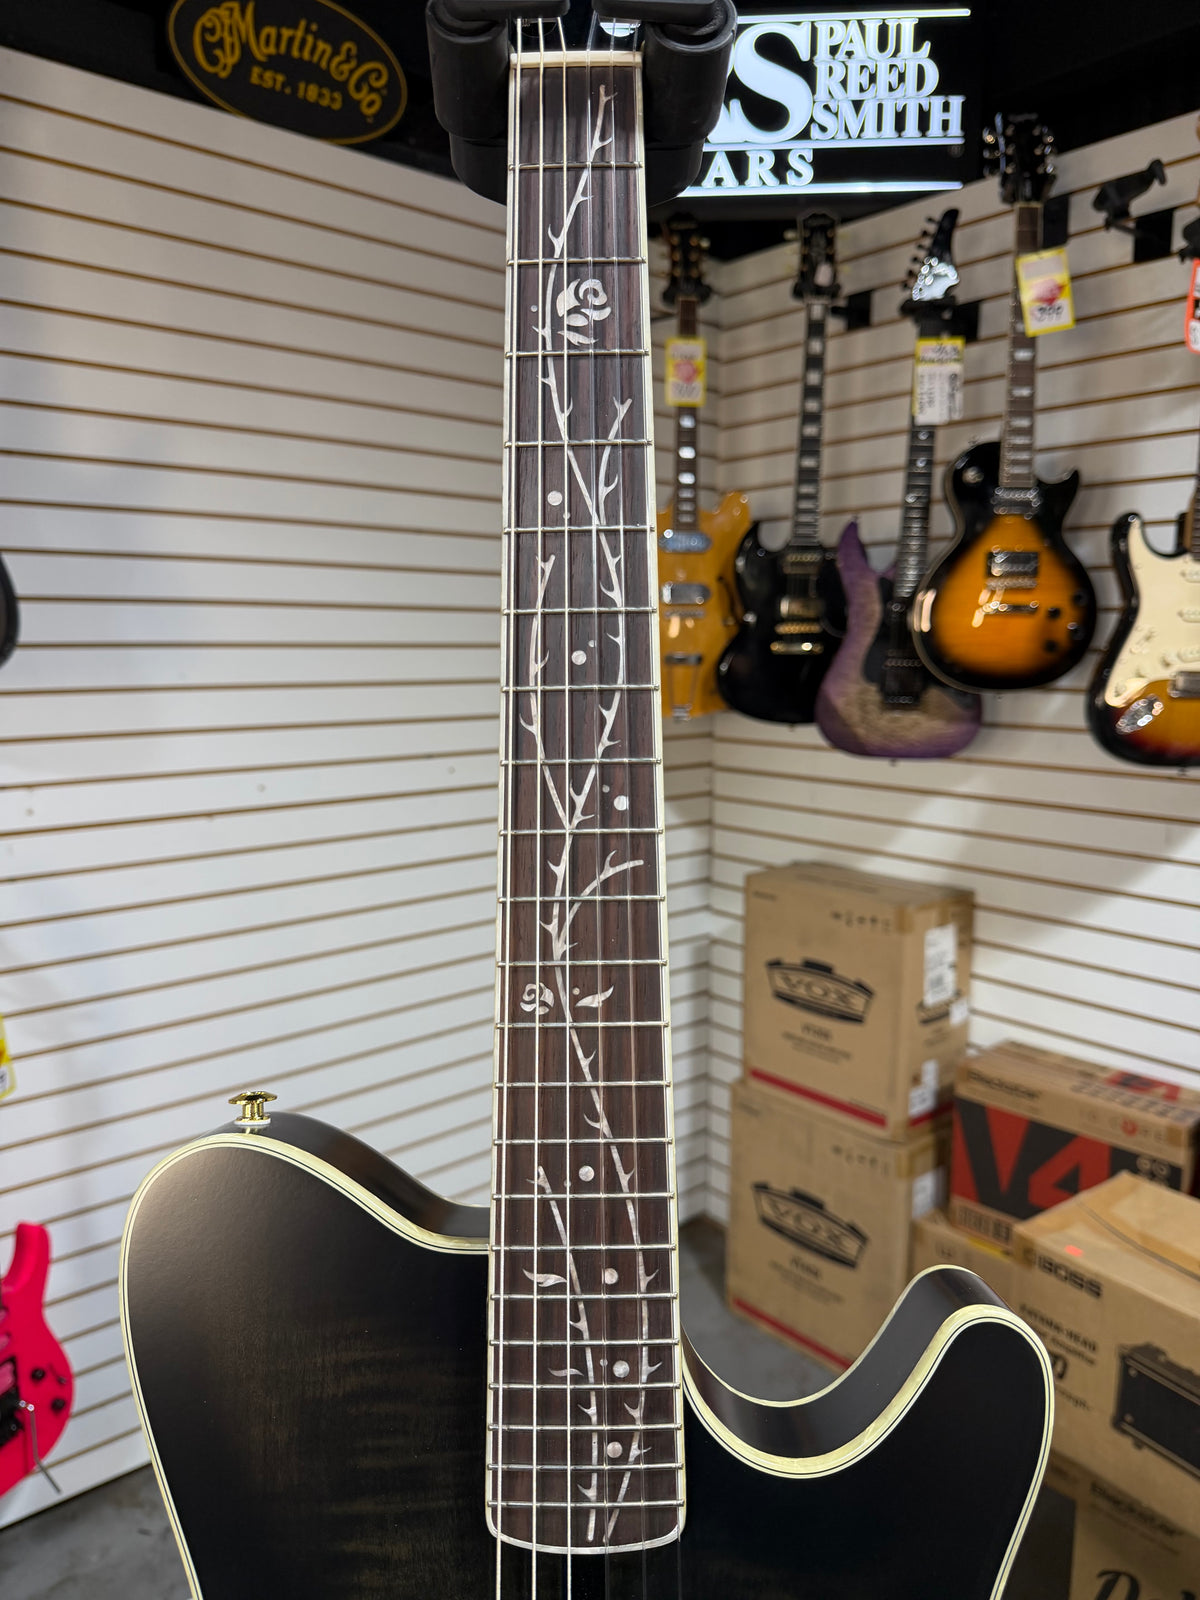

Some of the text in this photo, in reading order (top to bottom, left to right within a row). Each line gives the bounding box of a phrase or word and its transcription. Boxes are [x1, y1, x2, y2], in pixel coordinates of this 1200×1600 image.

[814, 18, 931, 60] PAUL
[250, 65, 292, 95] EST.
[813, 57, 940, 101] REED
[811, 95, 965, 140] SMITH
[780, 971, 855, 1008] VOX
[1037, 1254, 1103, 1299] BOSS
